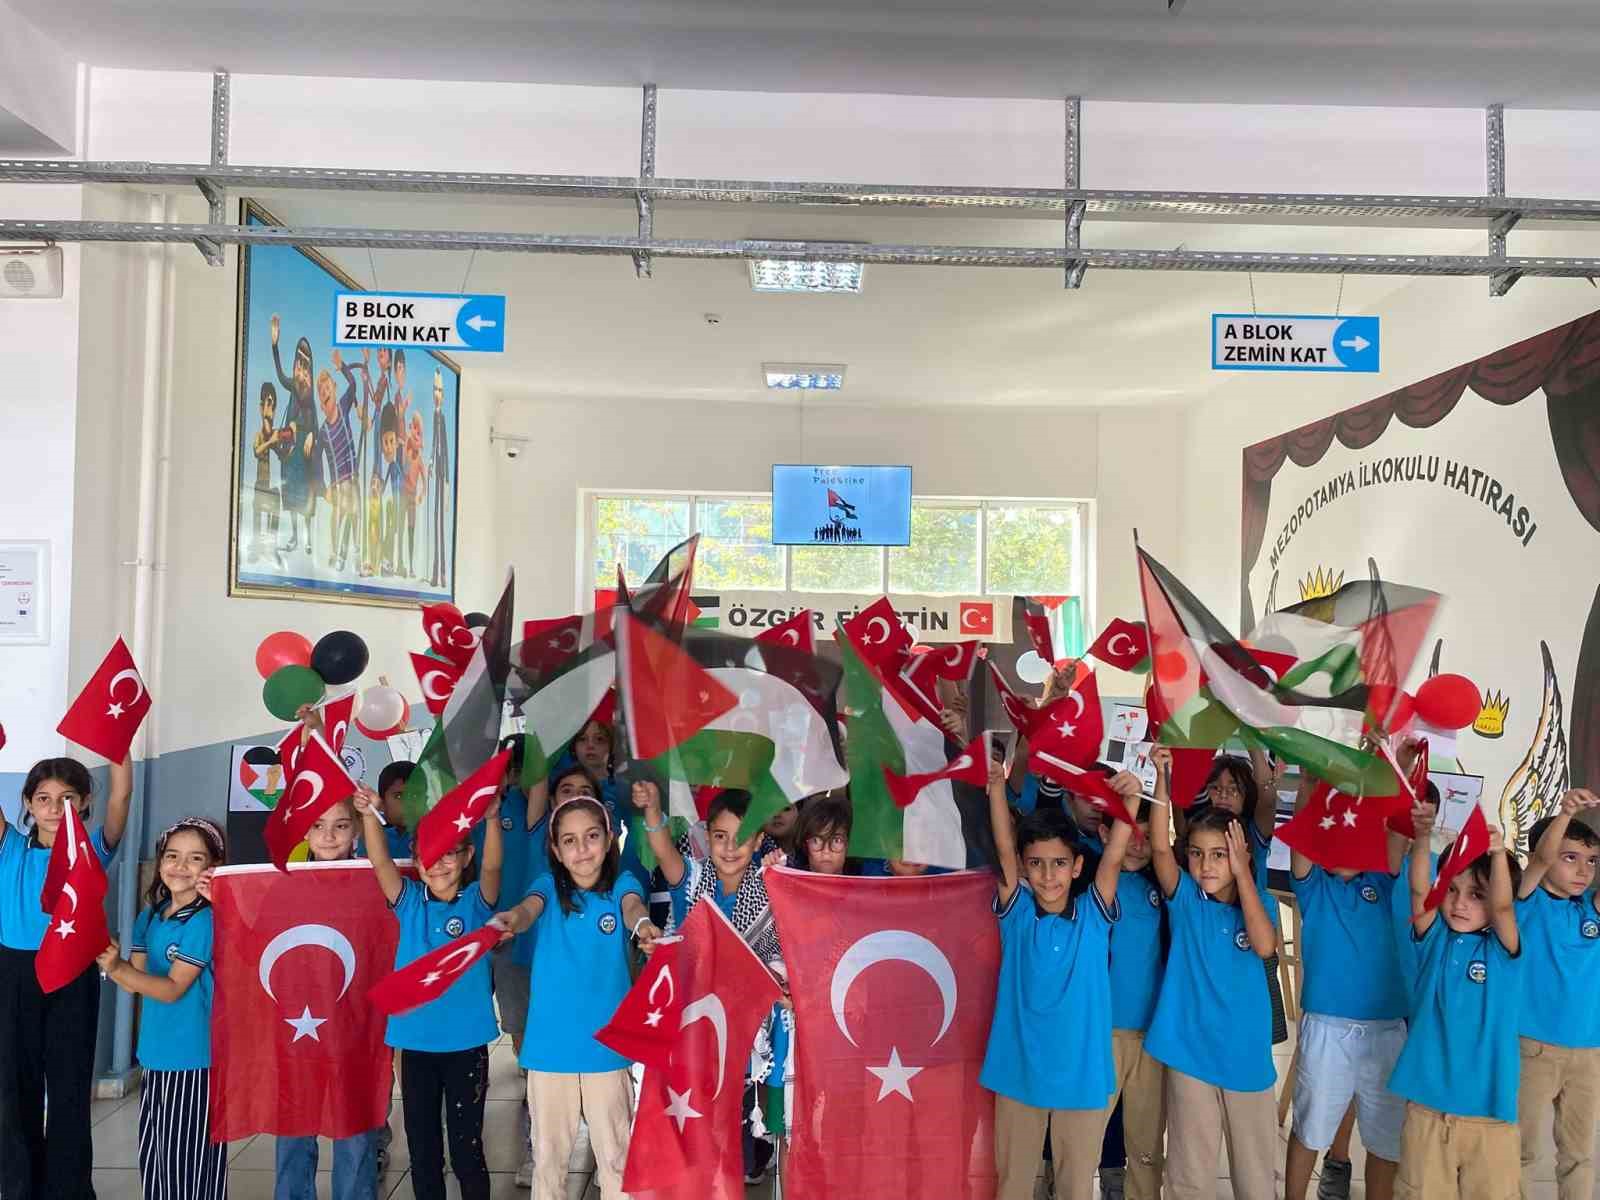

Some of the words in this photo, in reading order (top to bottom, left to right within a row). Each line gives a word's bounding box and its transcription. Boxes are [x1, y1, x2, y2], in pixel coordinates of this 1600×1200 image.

[346, 302, 358, 317] B
[363, 303, 414, 318] BLOK
[344, 322, 407, 341] ZEMİN
[412, 326, 450, 342] KAT
[1224, 324, 1237, 339] A
[1243, 325, 1292, 340] BLOK
[1224, 343, 1285, 362] ZEMİN
[1291, 348, 1327, 362] KAT
[1269, 471, 1355, 570] MEZOPOTAMYA
[1359, 454, 1440, 488] İLKOKULU
[1443, 460, 1537, 547] HATIRASI
